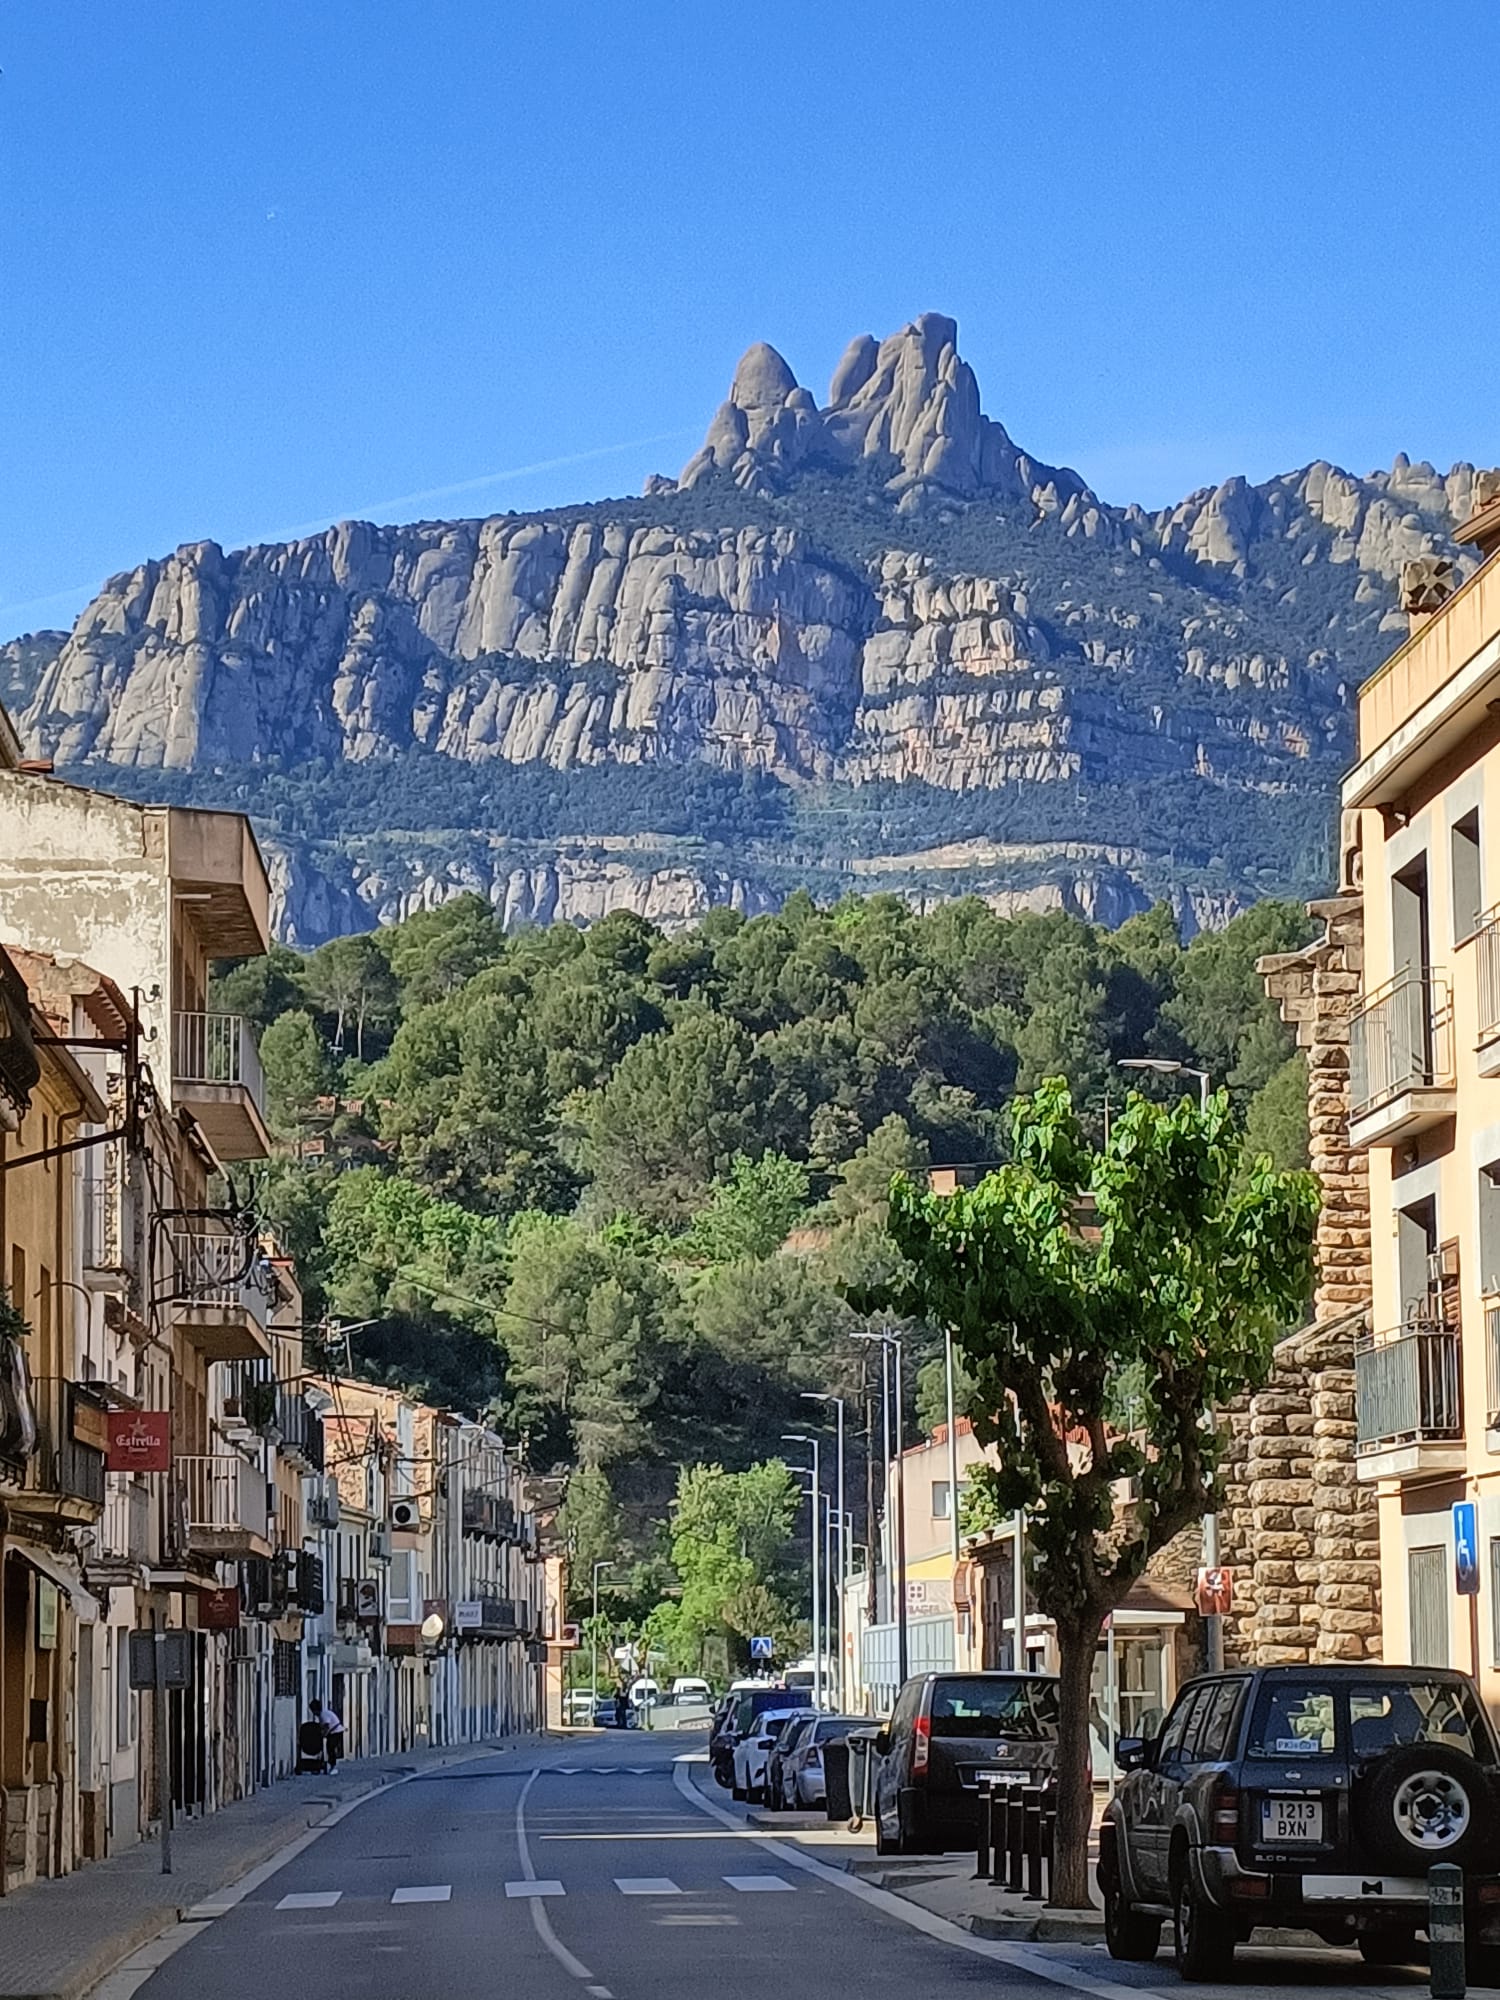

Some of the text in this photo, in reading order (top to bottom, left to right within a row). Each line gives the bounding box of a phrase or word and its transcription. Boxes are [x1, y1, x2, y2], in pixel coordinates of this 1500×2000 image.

[115, 1434, 160, 1447] Estrella
[1278, 1803, 1315, 1819] 1213
[1278, 1820, 1307, 1837] BXN
